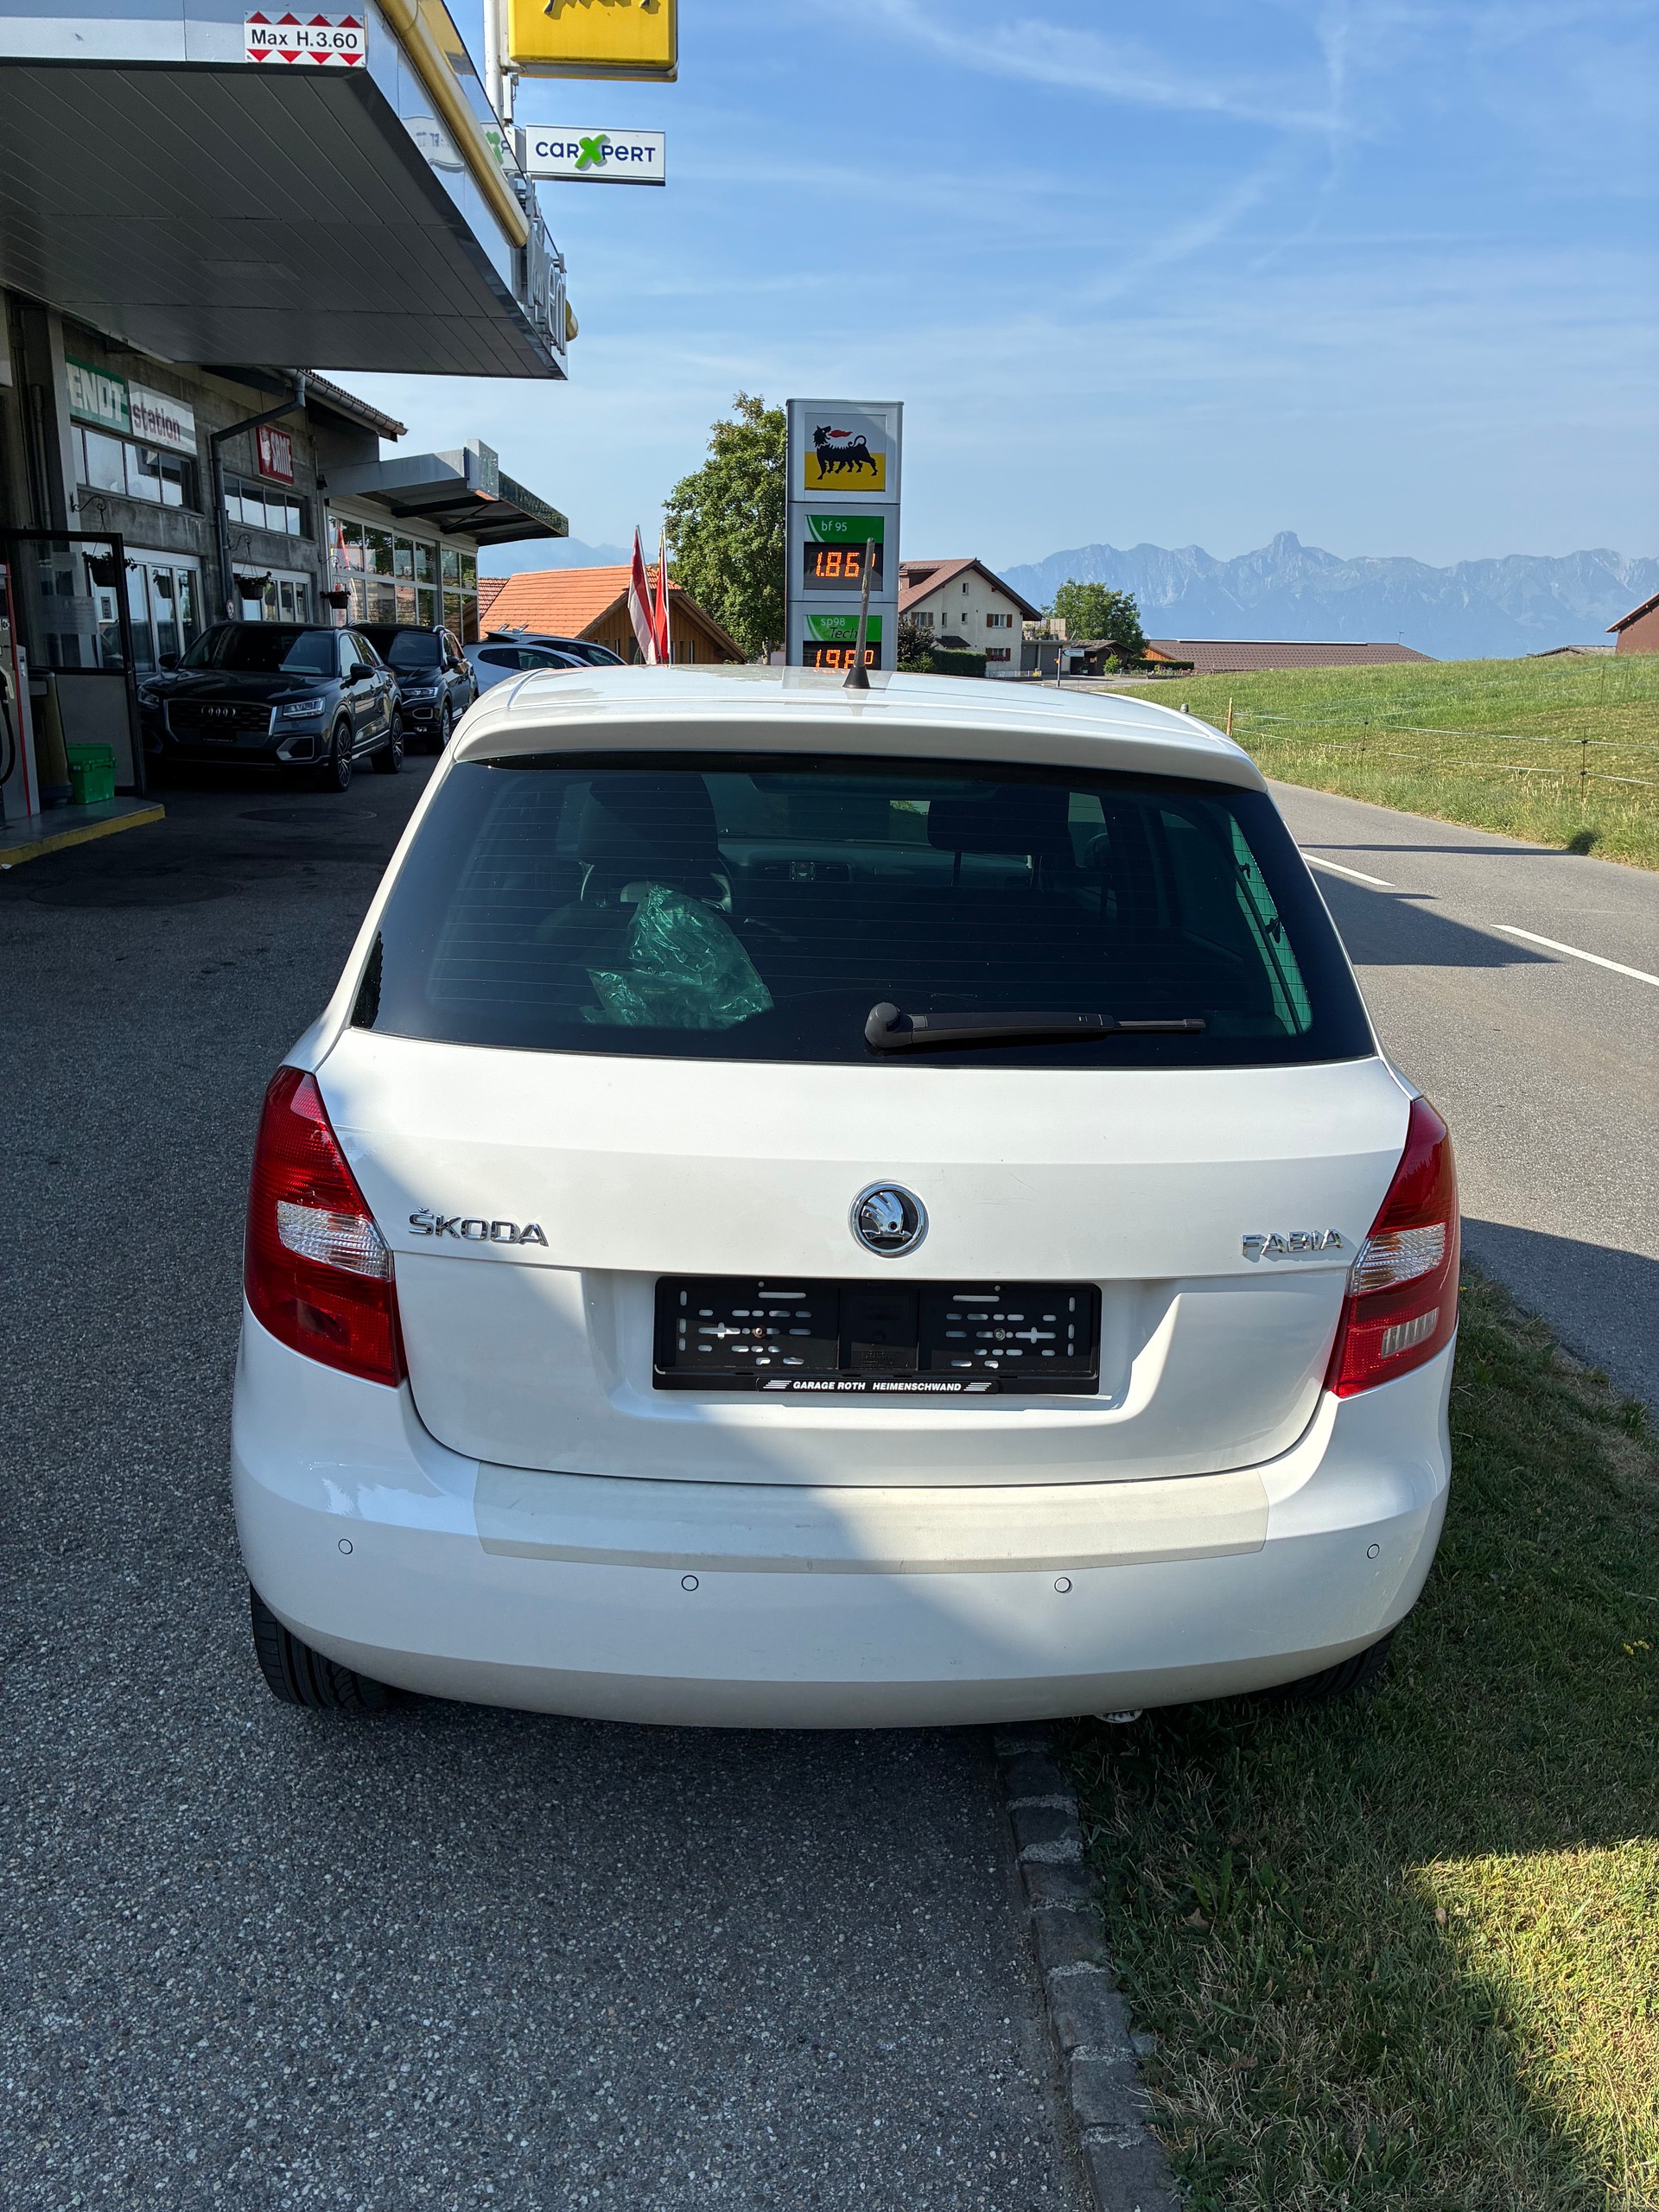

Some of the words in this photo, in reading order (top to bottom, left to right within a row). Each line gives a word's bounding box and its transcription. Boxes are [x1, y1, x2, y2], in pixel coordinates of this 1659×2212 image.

[251, 29, 288, 45] Max
[296, 31, 358, 48] H.3.60
[132, 402, 181, 442] station
[822, 520, 833, 531] bf
[835, 522, 848, 531] 95
[821, 617, 846, 627] sp98
[409, 1207, 549, 1247] ŠKODA
[1241, 1229, 1344, 1255] FABIA
[793, 1382, 835, 1390] GARAGE
[837, 1382, 866, 1390] ROTH
[872, 1382, 962, 1392] HEIMENSCHWAND
